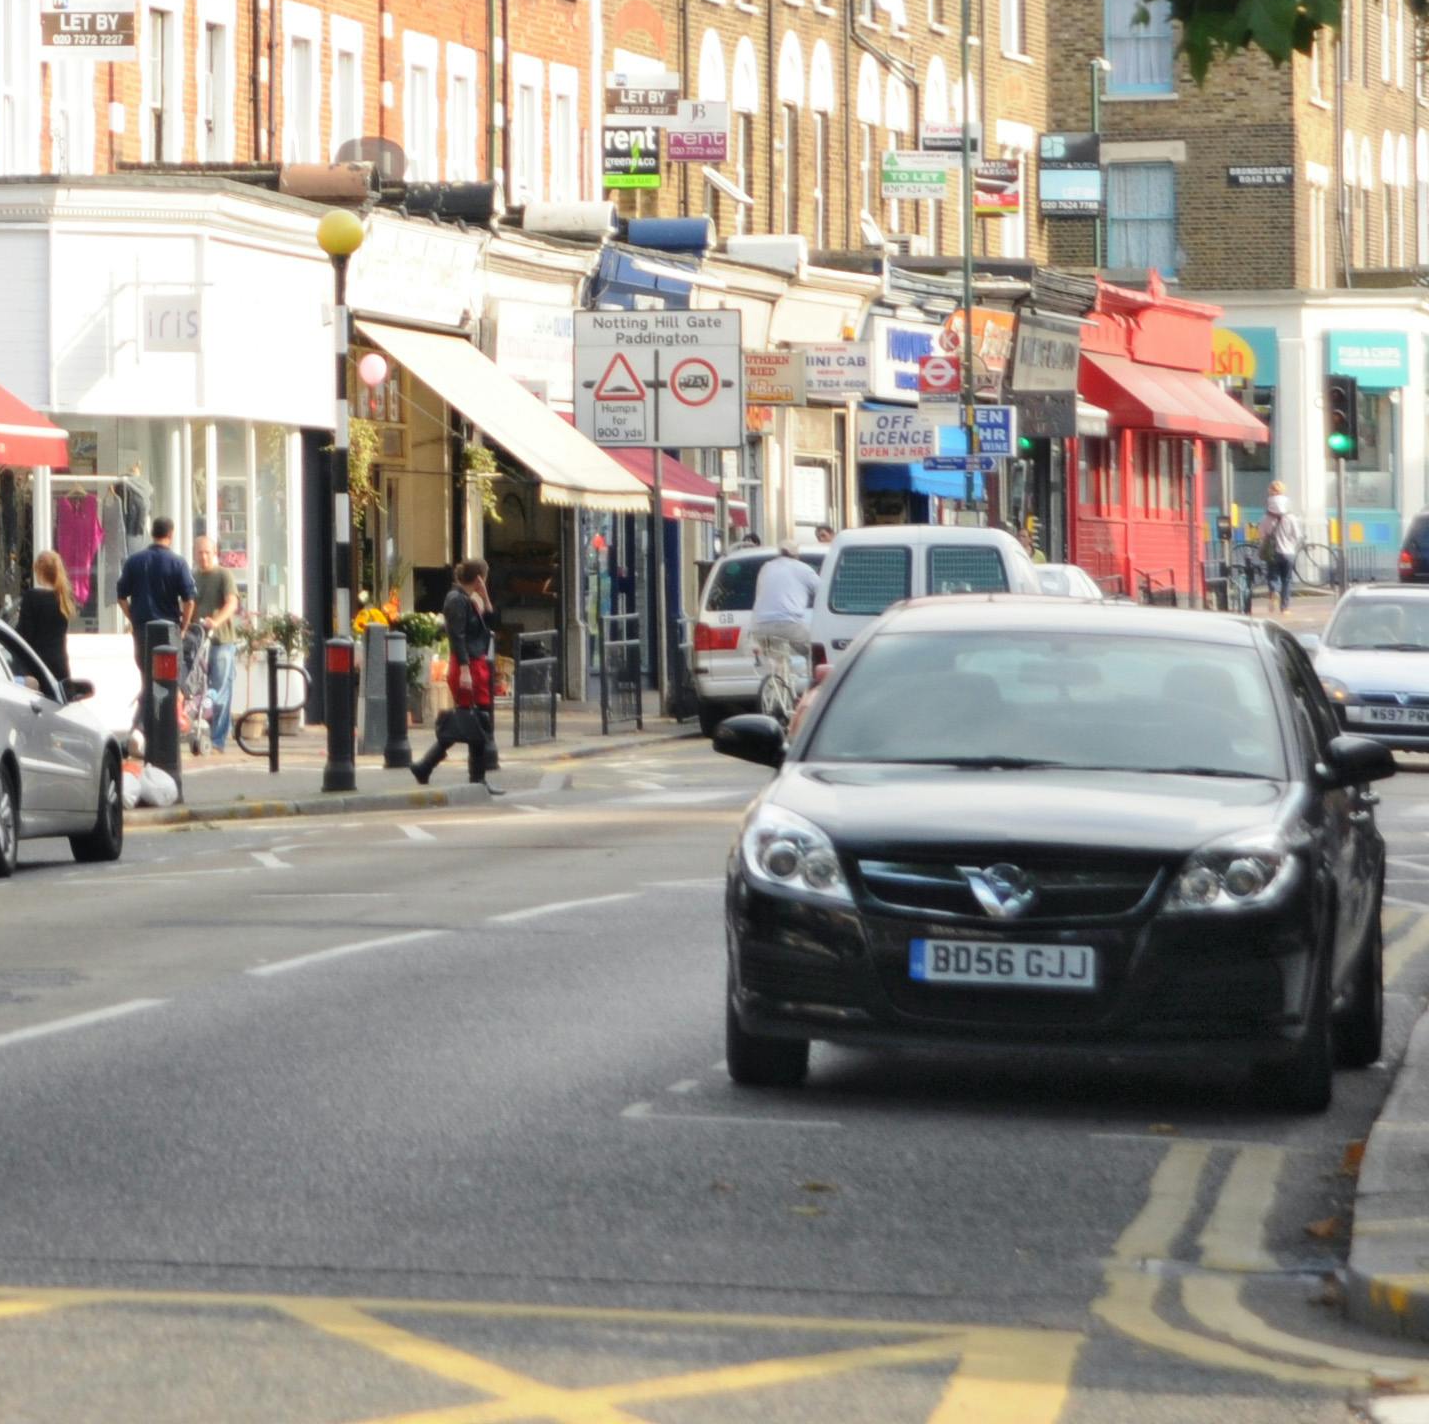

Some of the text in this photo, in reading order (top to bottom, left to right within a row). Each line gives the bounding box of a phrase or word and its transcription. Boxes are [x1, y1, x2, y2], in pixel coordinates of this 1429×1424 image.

[60, 13, 119, 32] LET BY
[73, 34, 98, 46] 7372
[99, 34, 124, 46] 7227
[621, 90, 666, 104] LET BY
[604, 127, 657, 151] rent
[669, 132, 725, 146] rent
[891, 172, 939, 182] TO LET
[1238, 175, 1263, 184] ROAD
[1041, 201, 1058, 210] 020
[148, 309, 198, 339] iris
[593, 316, 723, 331] Notting Hill Gate
[615, 333, 699, 346] Paddington
[836, 356, 867, 367] CAB
[601, 404, 638, 416] Humps
[612, 415, 627, 425] for
[877, 415, 914, 429] OFF
[597, 427, 643, 440] 900 yds
[859, 429, 934, 446] LICENCE
[859, 446, 932, 457] OPEN 24 HRS
[718, 612, 734, 625] GB
[932, 944, 1087, 980] BD56 GJJ
